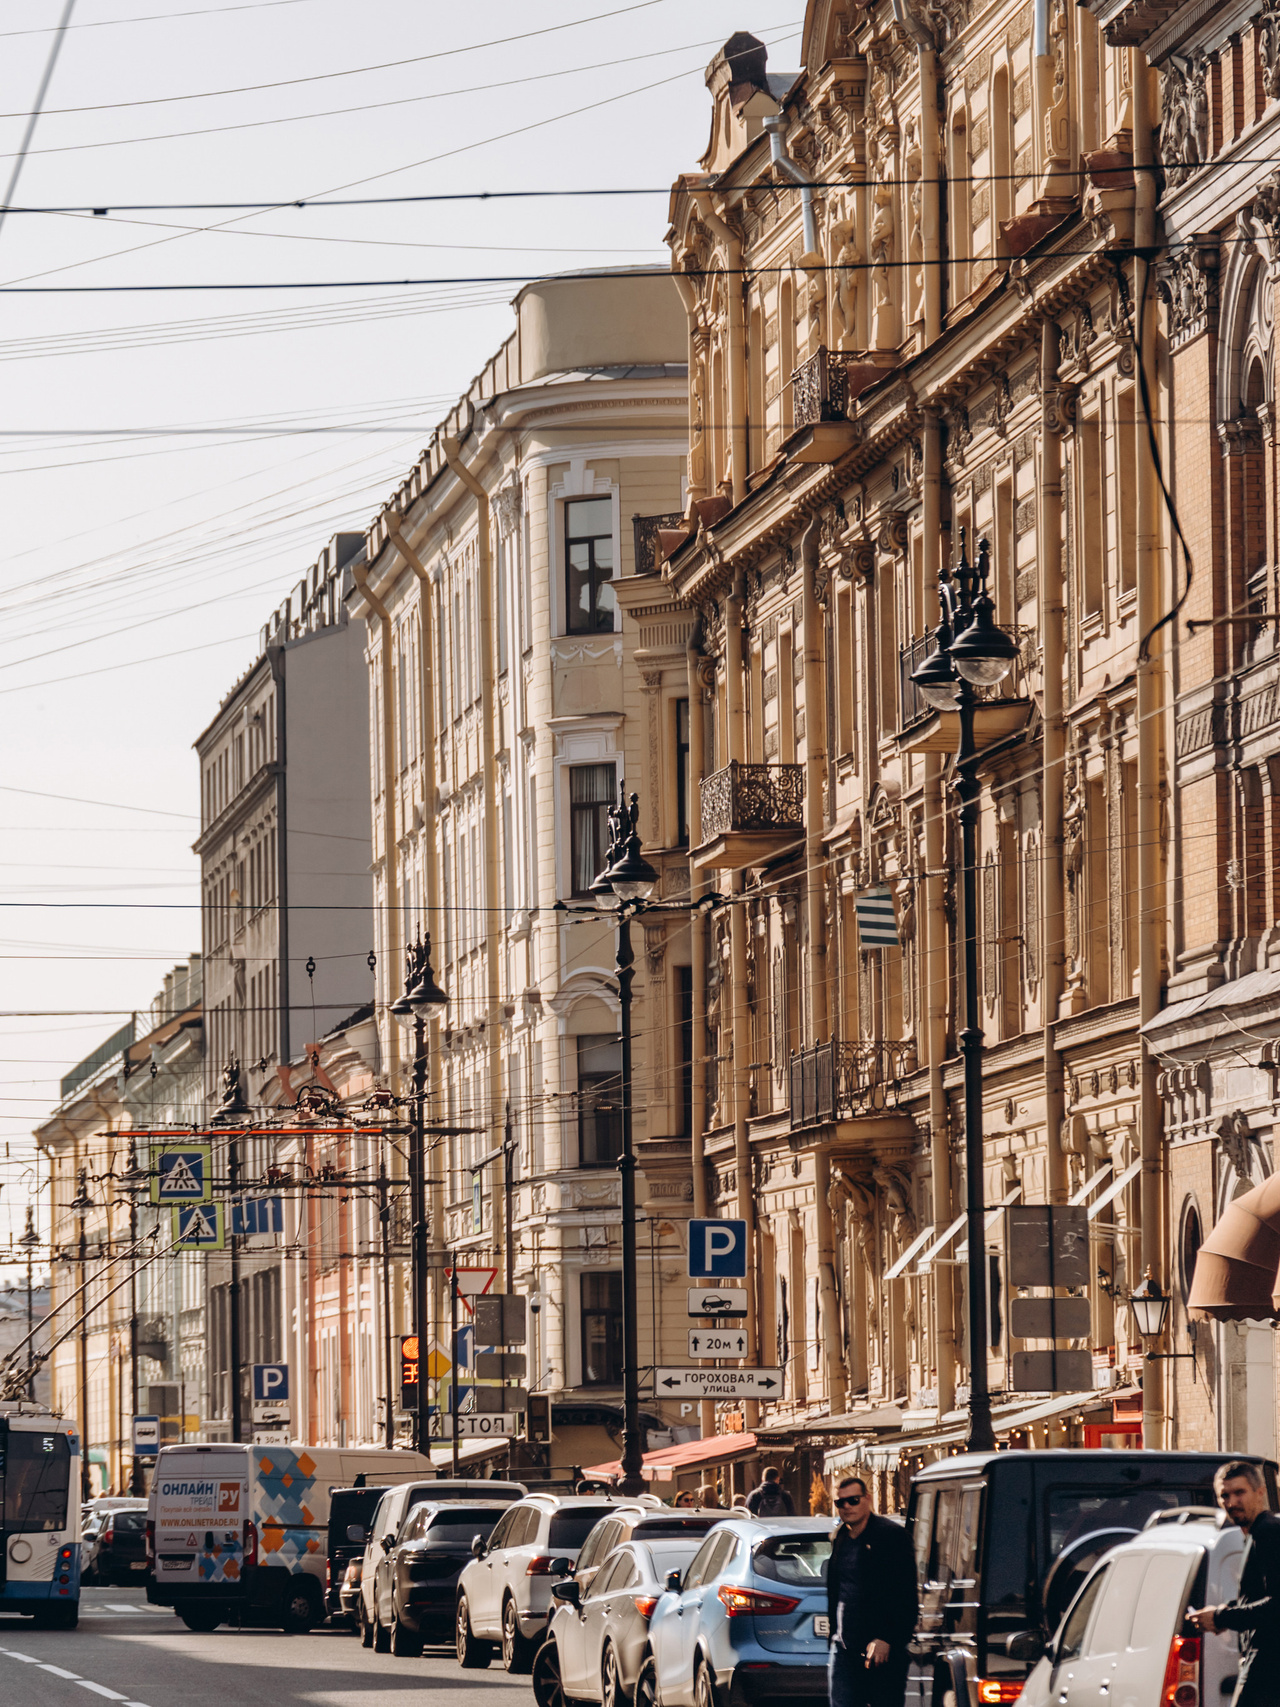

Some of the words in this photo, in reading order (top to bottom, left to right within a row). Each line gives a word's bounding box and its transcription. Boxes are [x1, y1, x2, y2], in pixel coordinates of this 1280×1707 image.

[704, 1226, 736, 1272] P
[706, 1338, 731, 1350] 20м
[262, 1368, 283, 1397] P
[685, 1373, 754, 1384] ГОРОХОВАЯ
[703, 1385, 736, 1395] улица
[457, 1417, 505, 1434] СТОП
[42, 1437, 55, 1452] 5
[162, 1481, 214, 1496] ОНЛАЙН
[190, 1496, 213, 1506] ТРЕЙД
[220, 1490, 239, 1506] РУ
[160, 1518, 239, 1527] WWW.ONLINETRADE.RU
